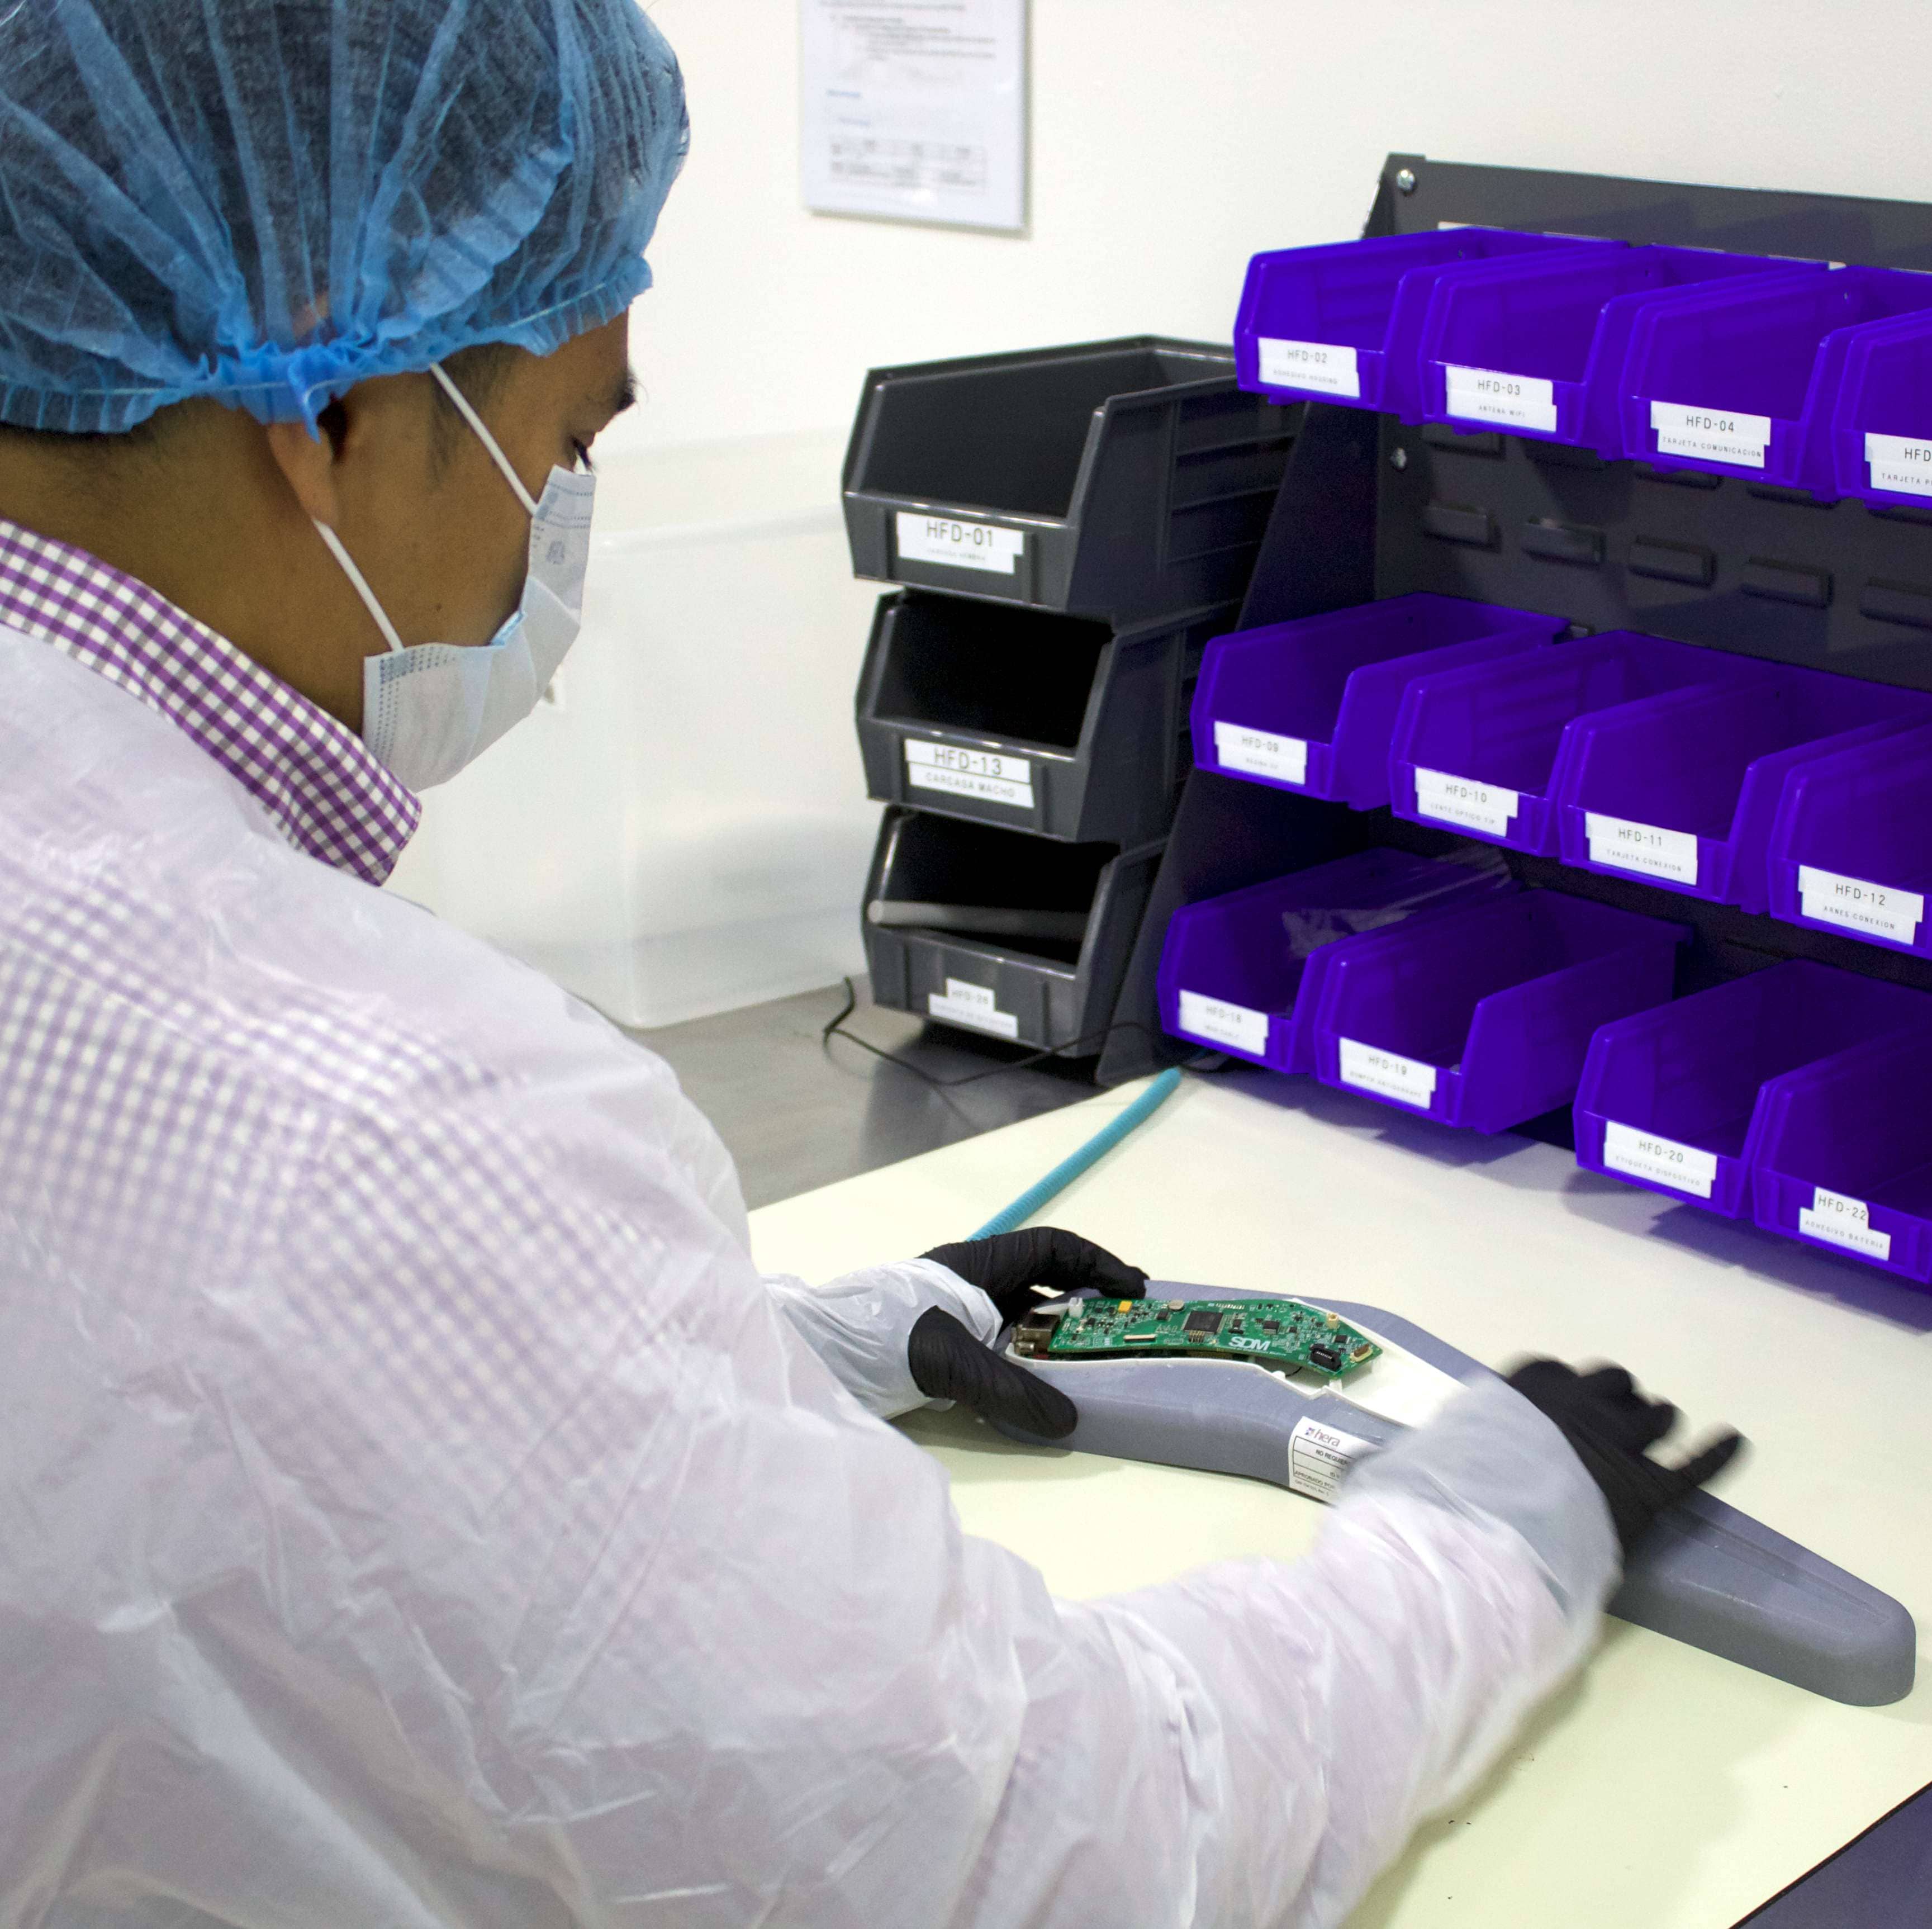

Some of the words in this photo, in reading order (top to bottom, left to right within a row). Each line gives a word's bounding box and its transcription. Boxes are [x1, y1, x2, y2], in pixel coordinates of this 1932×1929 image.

[1287, 349, 1328, 363] HFD-02
[1478, 380, 1521, 396] HFD-03
[1479, 405, 1506, 414] ANTENA
[1509, 410, 1526, 418] WIFI
[1686, 415, 1734, 432] HFD-04
[1662, 436, 1697, 447] TARJETA
[1701, 443, 1762, 457] COMUNICACION
[1882, 473, 1921, 484] TARJETA
[926, 520, 993, 547] HFD-01
[934, 747, 1002, 775] HFD-13
[979, 783, 1015, 798] MACHO
[1446, 783, 1487, 803] HFD-10
[1455, 809, 1480, 821] OPTICO
[1618, 828, 1662, 846] HFD-11
[1607, 849, 1639, 861] TARJETA
[1643, 857, 1682, 871] CONEXION
[1835, 883, 1886, 906] HFD-12
[1824, 906, 1849, 918] ARNES
[1853, 913, 1895, 930] CONEXION
[1639, 1140, 1683, 1163] HFD-20
[1616, 1155, 1652, 1172] ETIQUETA
[1819, 1195, 1866, 1221] HFD-22
[1806, 1220, 1845, 1237] ADHESIVO
[1848, 1233, 1883, 1249] BATERIA
[1228, 1336, 1271, 1351] SDM
[1314, 1429, 1341, 1447] hera
